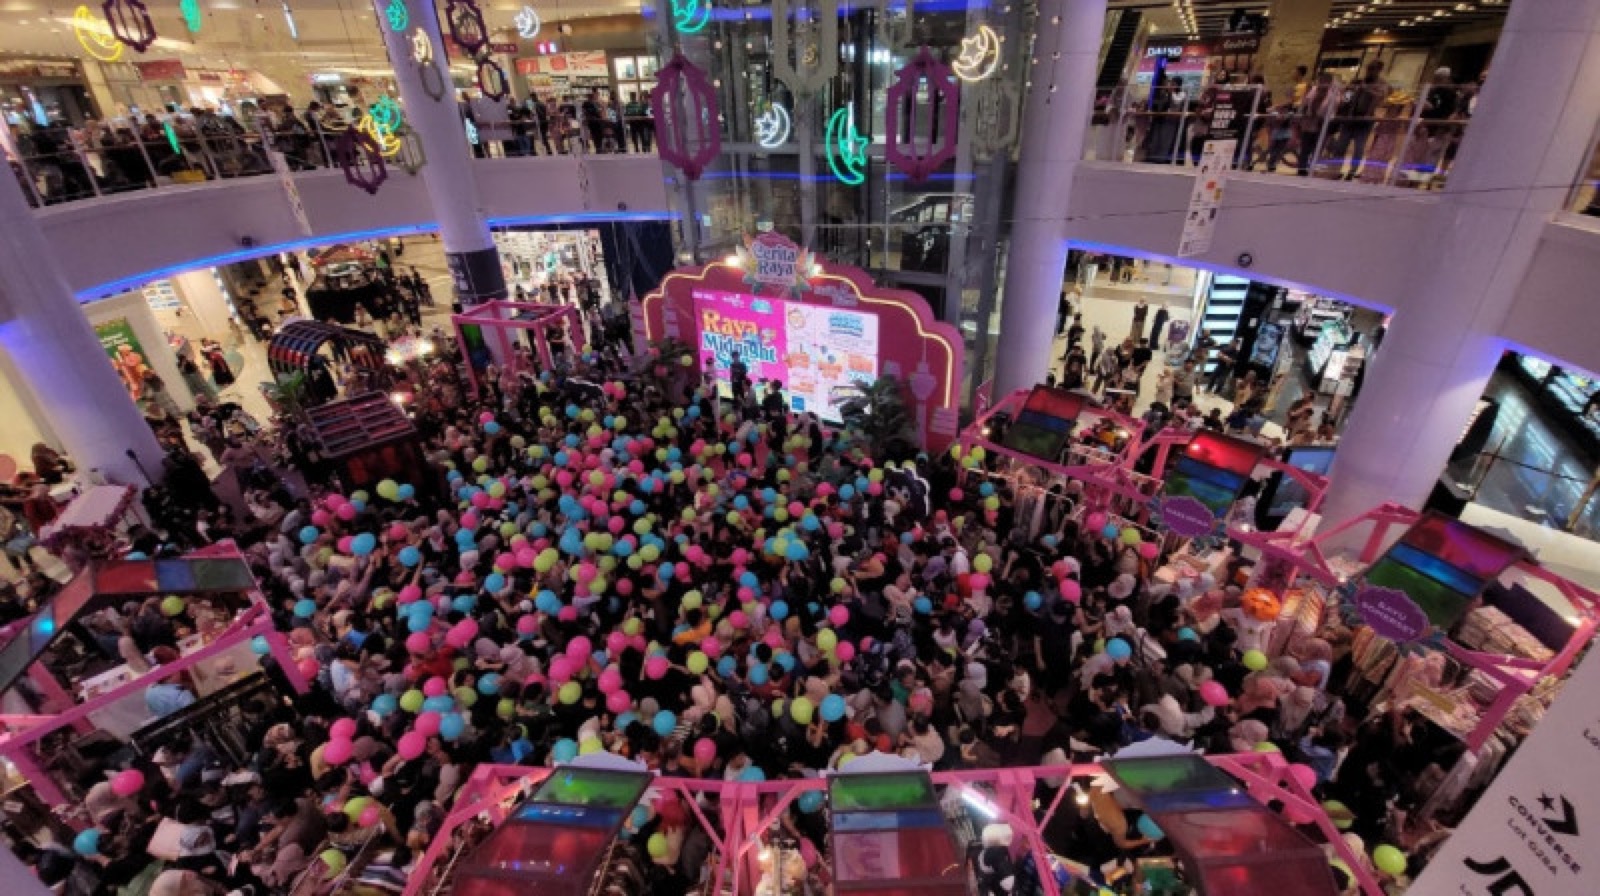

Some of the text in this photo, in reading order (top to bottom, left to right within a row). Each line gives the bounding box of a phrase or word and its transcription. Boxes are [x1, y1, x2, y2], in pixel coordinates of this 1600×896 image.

[754, 242, 796, 260] Cerita
[758, 259, 795, 277] Raya
[703, 310, 757, 341] Raya
[702, 331, 777, 364] Midnight
[1508, 795, 1581, 875] CONVERSE
